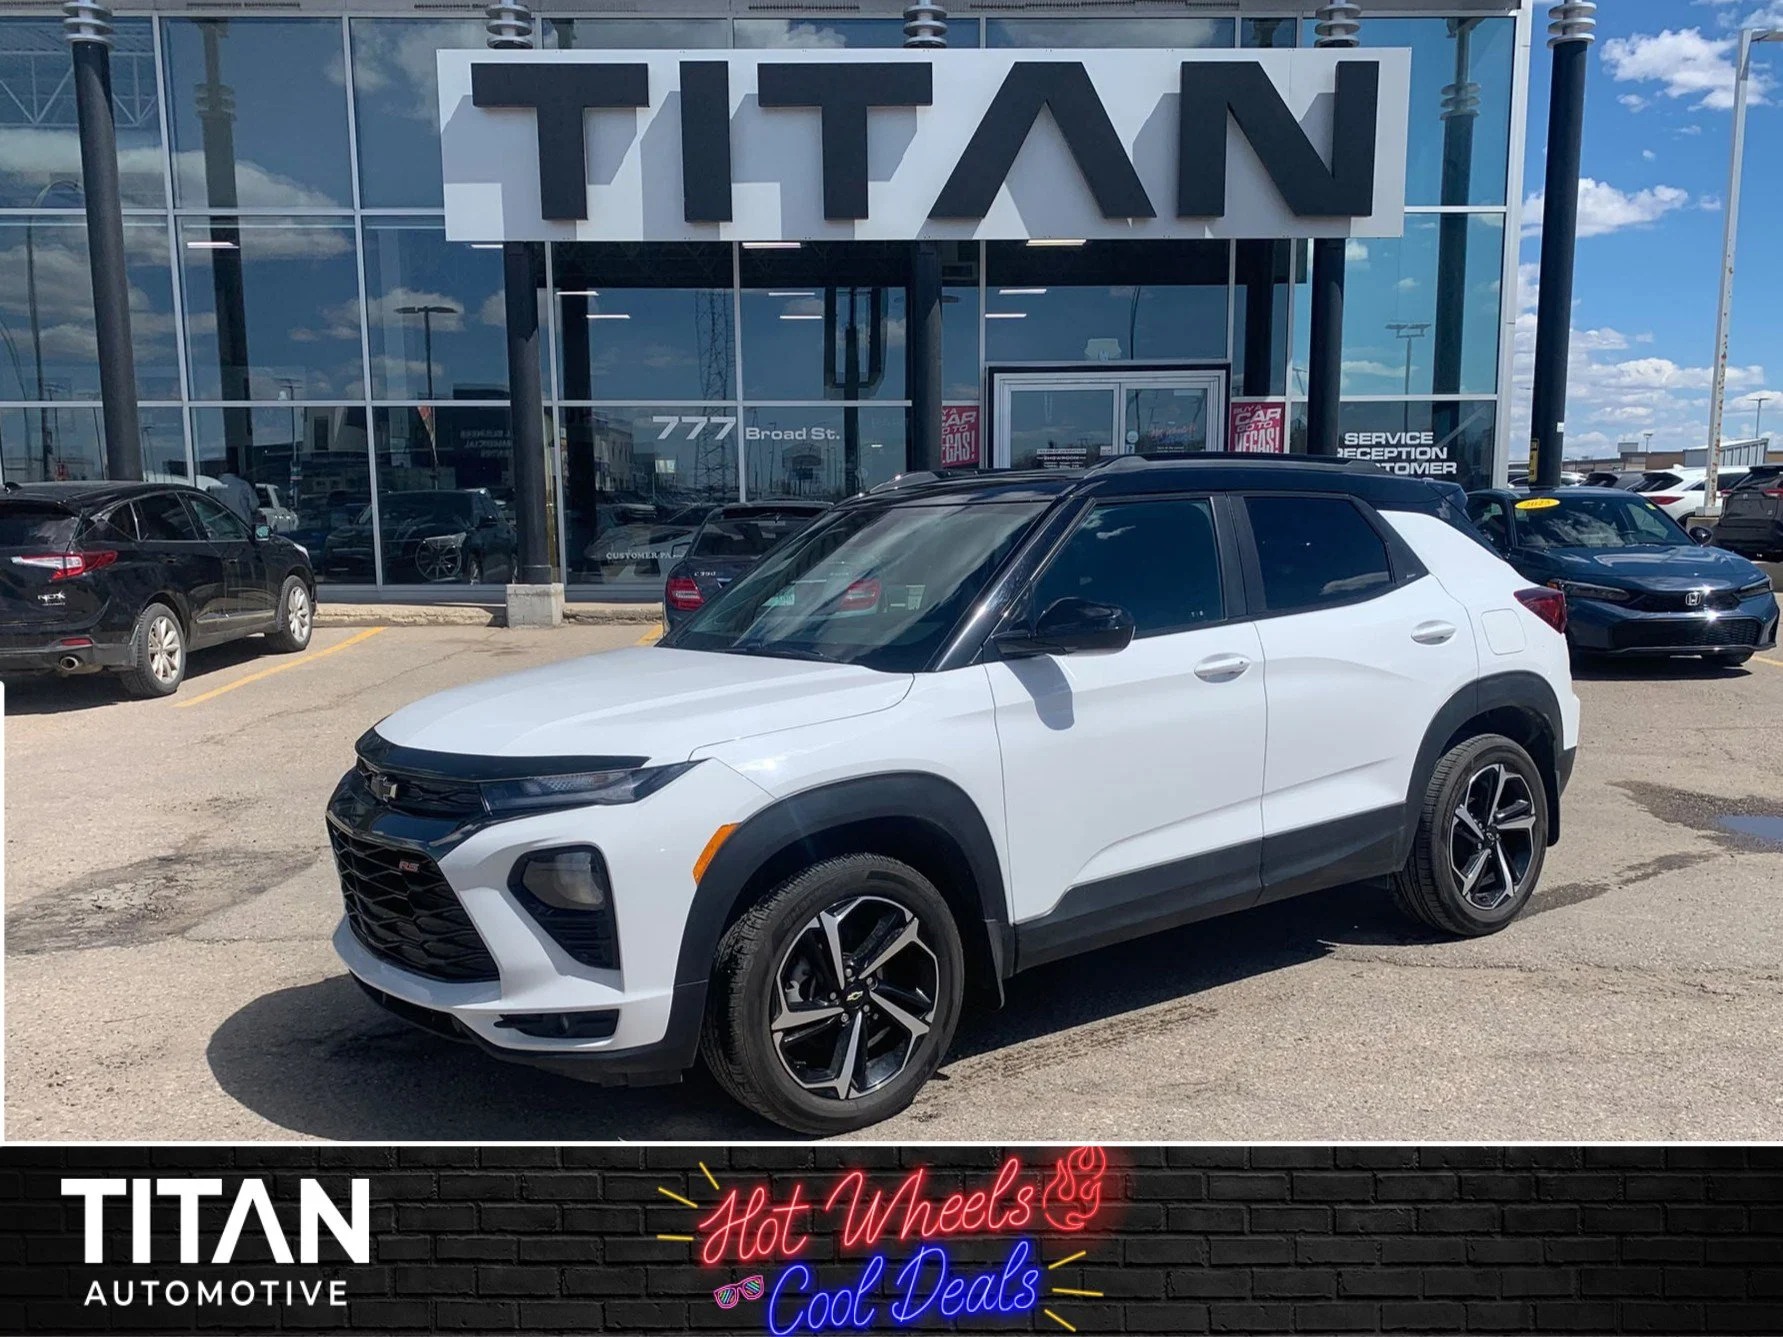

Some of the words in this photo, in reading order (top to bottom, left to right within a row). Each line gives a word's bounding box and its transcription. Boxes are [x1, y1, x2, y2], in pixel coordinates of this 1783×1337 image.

[472, 61, 1379, 222] TITAN
[1235, 408, 1282, 425] CAR
[652, 416, 737, 440] 777
[745, 427, 807, 440] Broad
[811, 428, 841, 440] St.
[1256, 420, 1273, 429] TO
[1344, 432, 1434, 445] SERVICE
[942, 430, 976, 463] GAS!
[1376, 462, 1457, 475] TOMER
[606, 552, 658, 560] CUSTOMER
